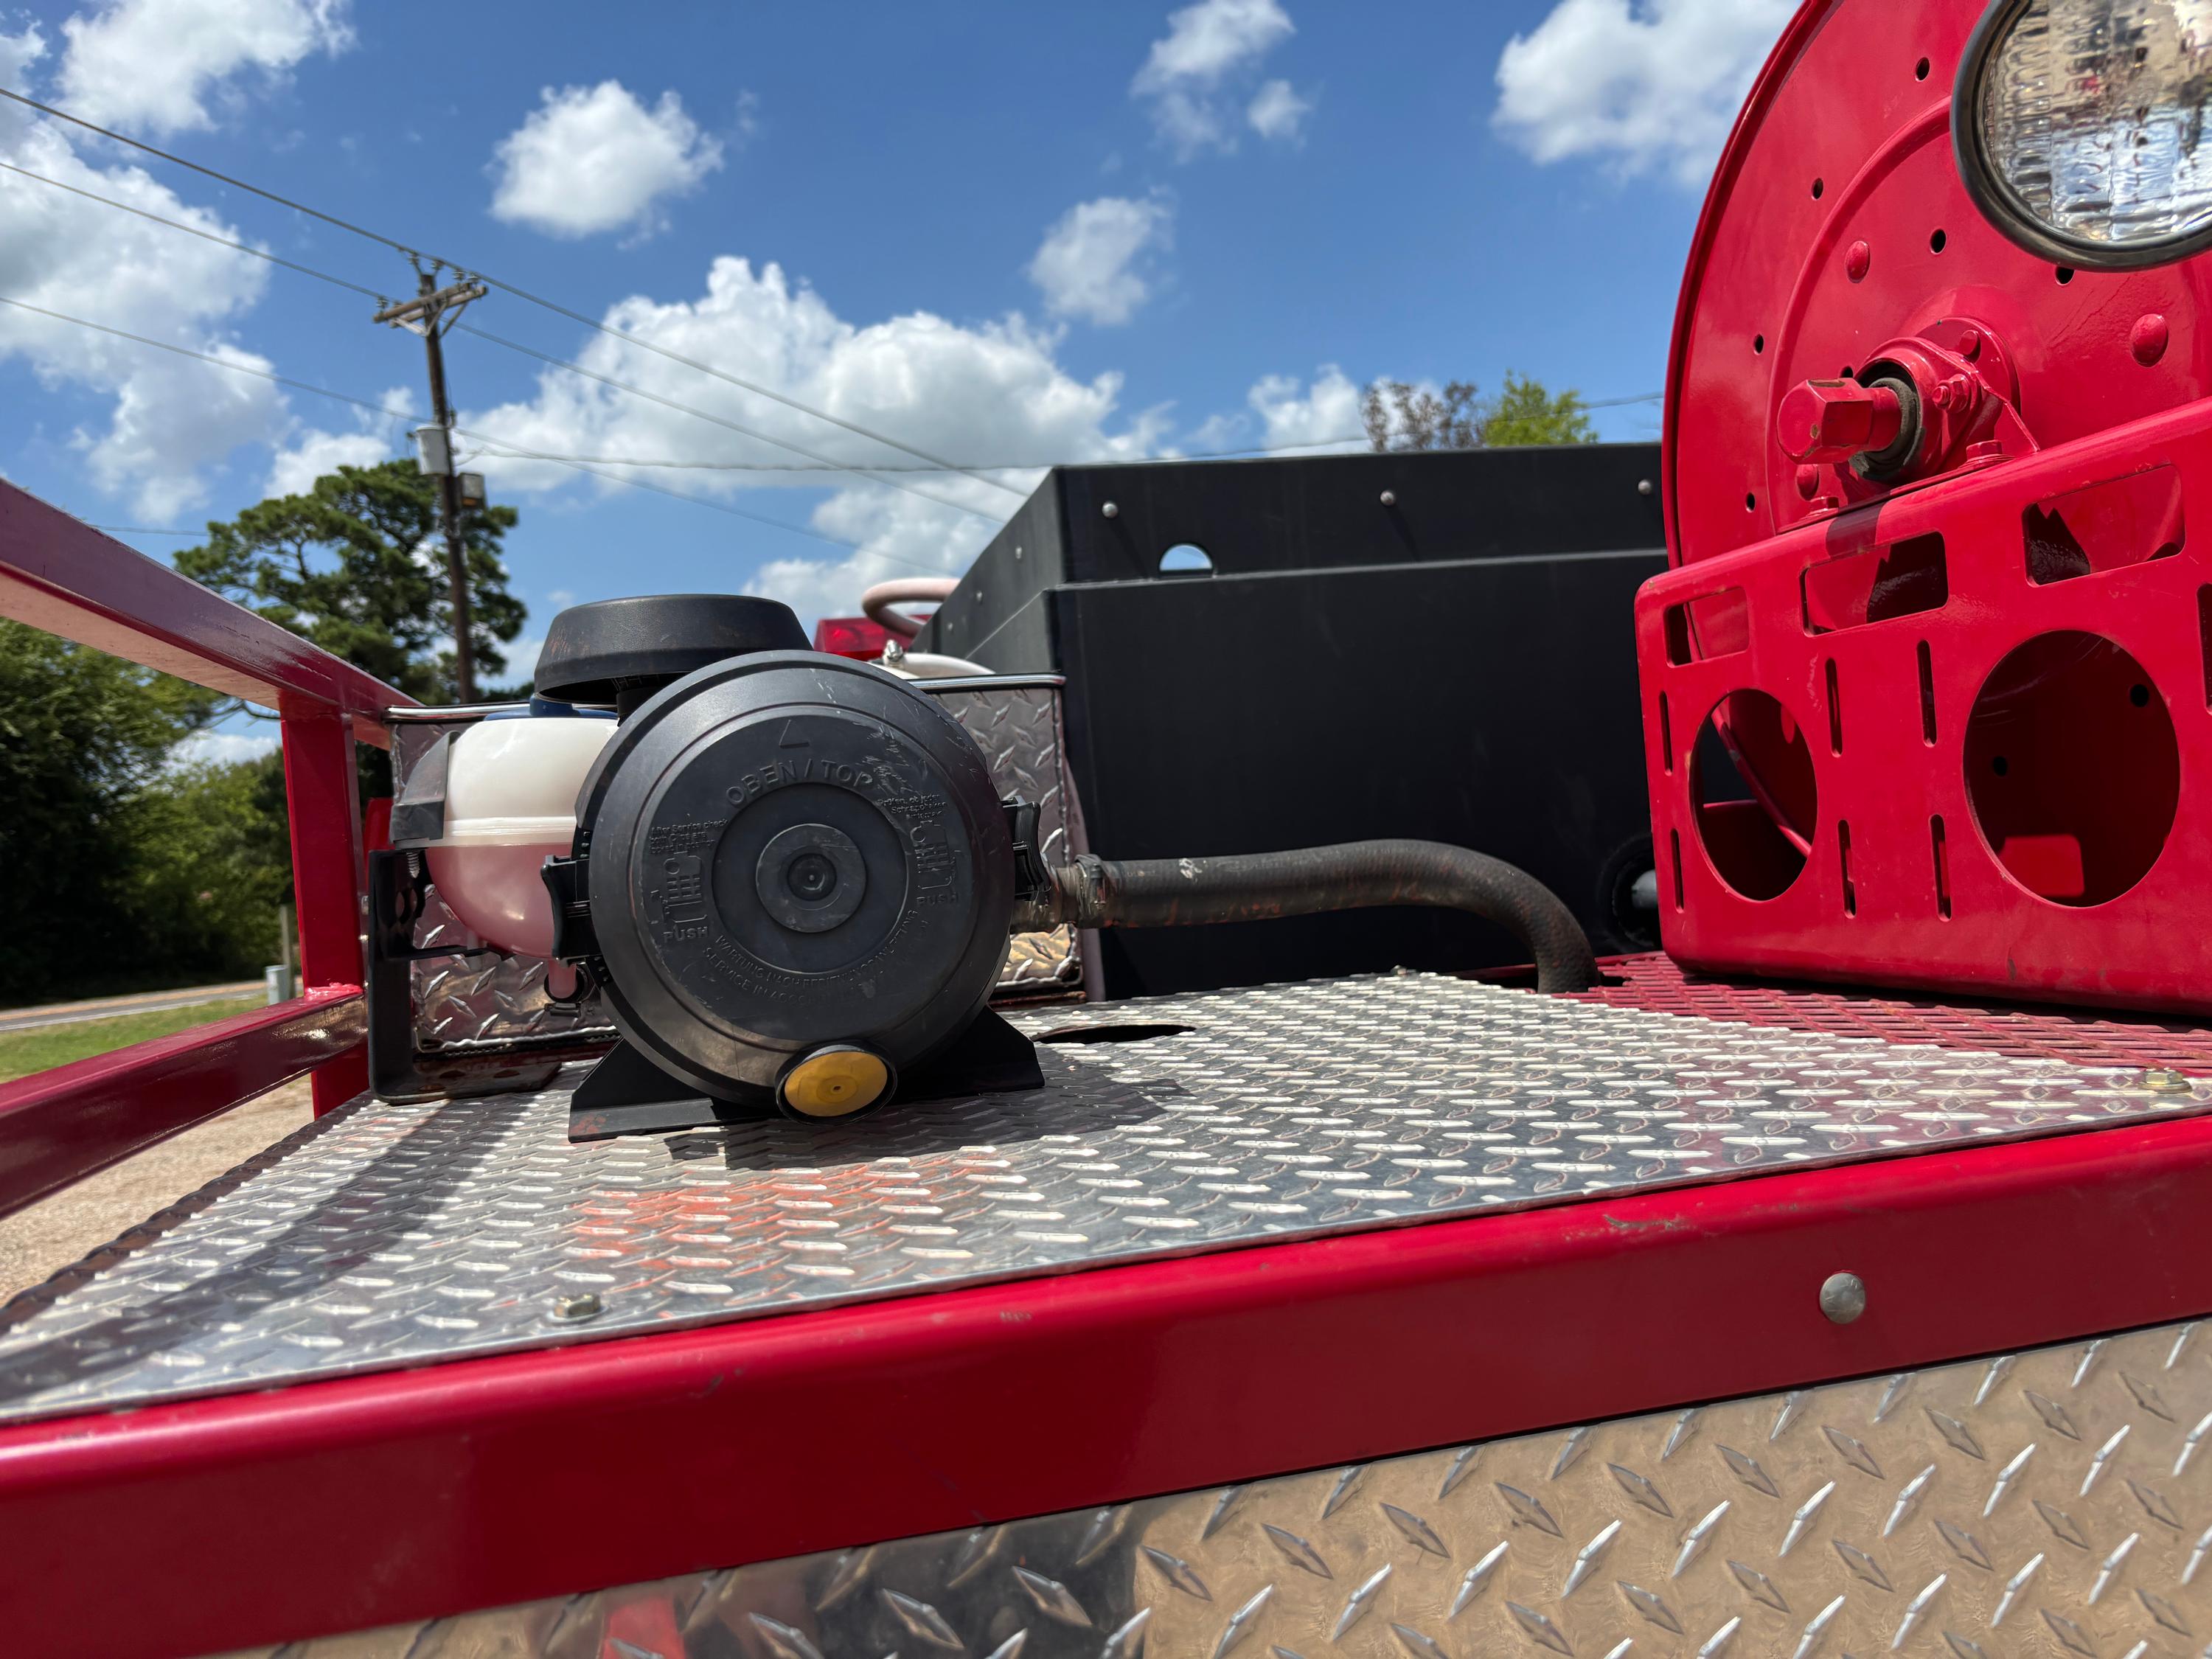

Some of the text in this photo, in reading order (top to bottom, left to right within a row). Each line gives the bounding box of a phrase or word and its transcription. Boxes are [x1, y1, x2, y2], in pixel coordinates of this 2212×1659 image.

[726, 758, 873, 804] OBEN / TOP
[916, 892, 958, 908] PUSH
[663, 925, 709, 943] PUSH
[702, 947, 751, 990] SERVICE
